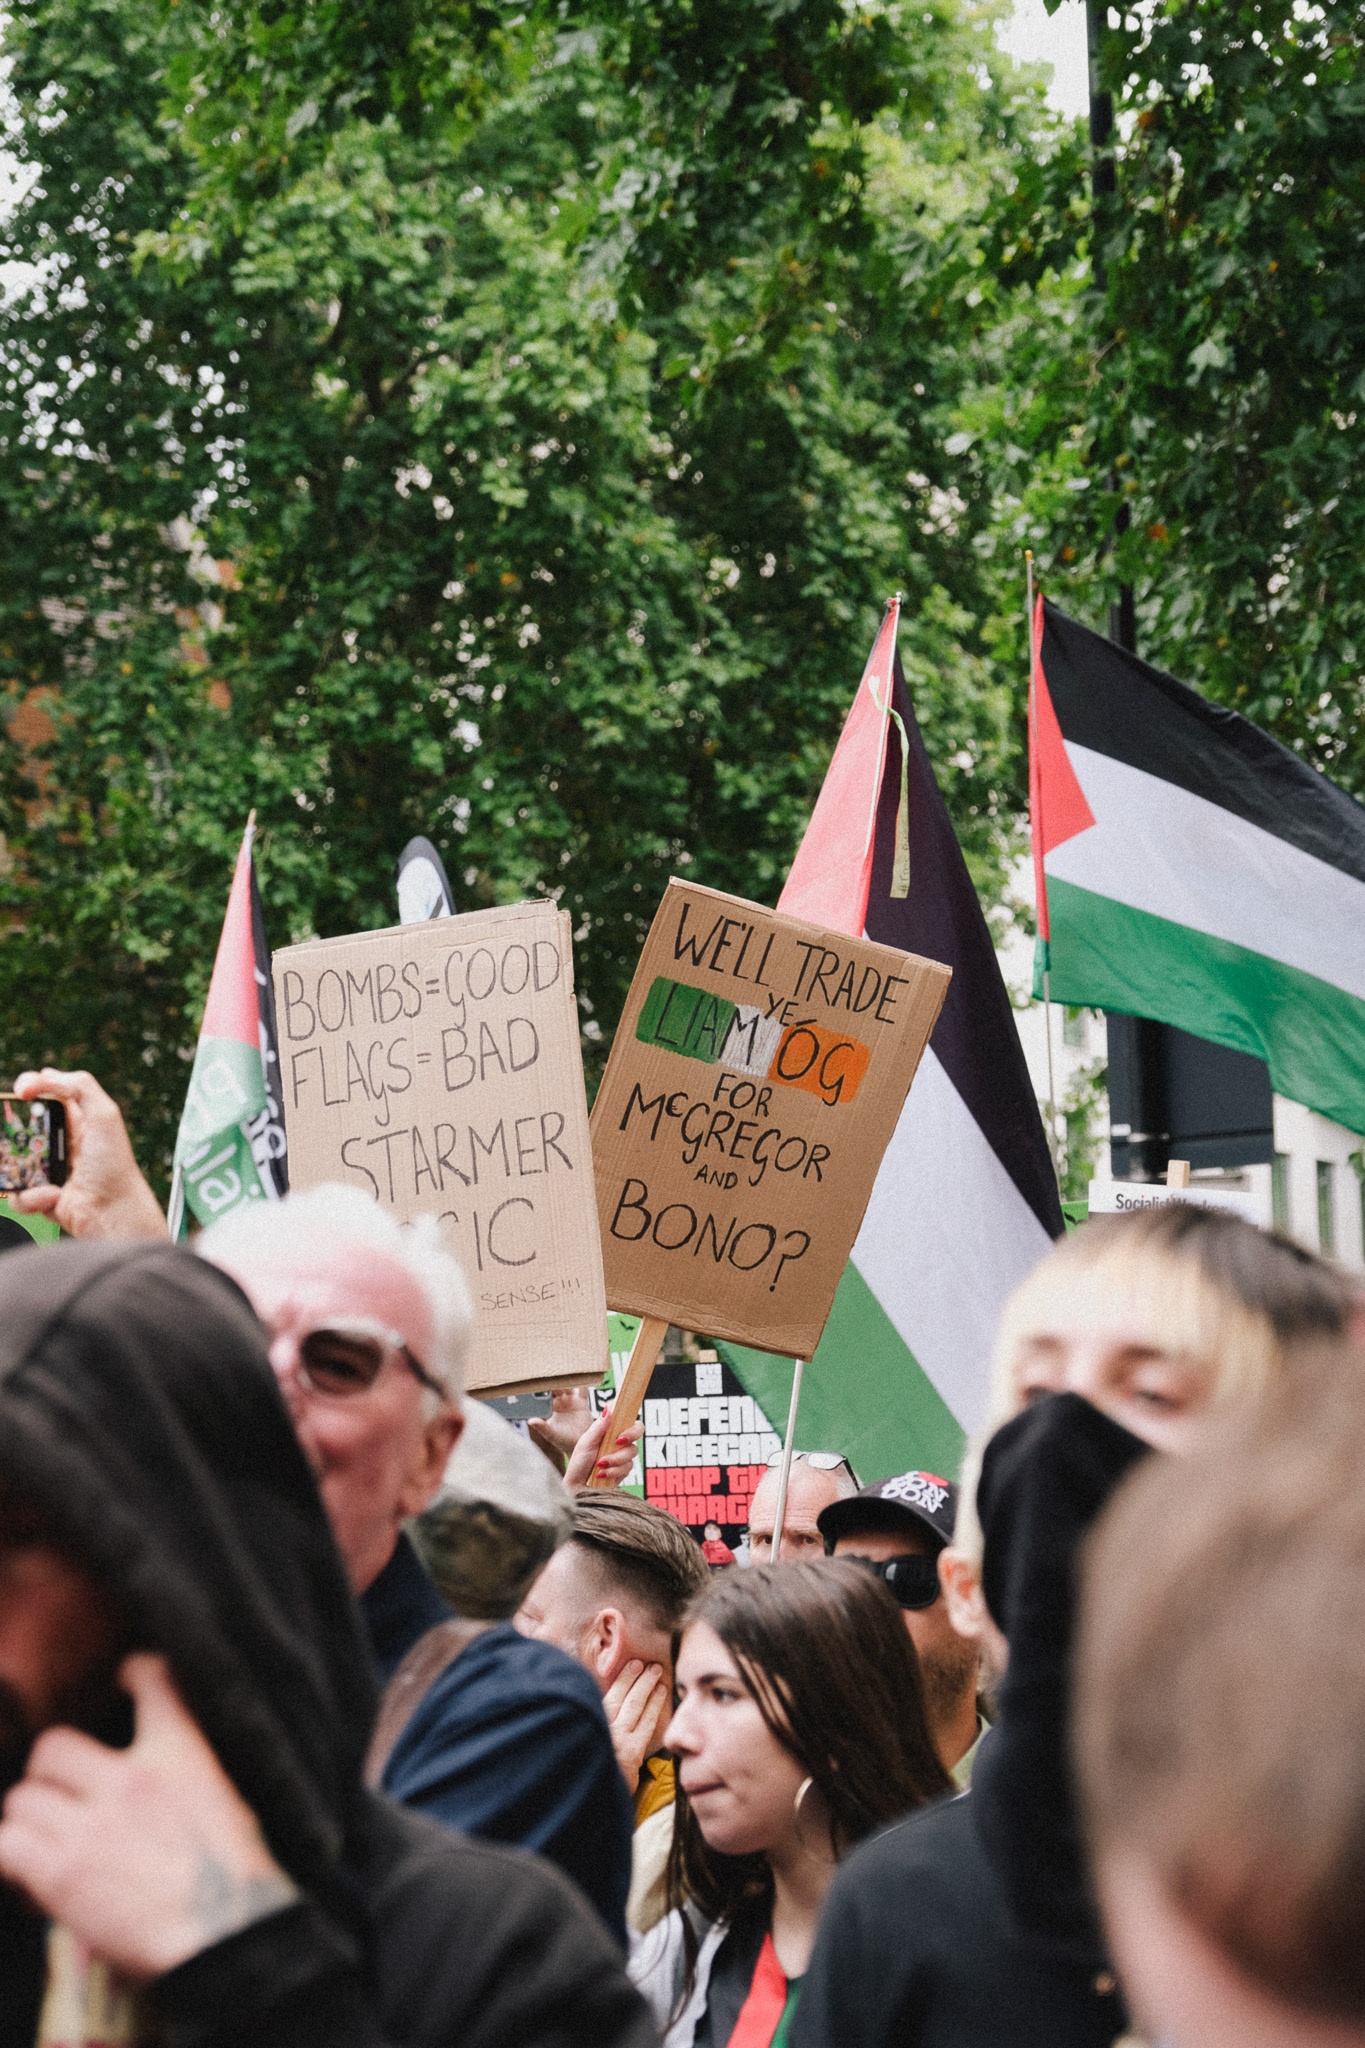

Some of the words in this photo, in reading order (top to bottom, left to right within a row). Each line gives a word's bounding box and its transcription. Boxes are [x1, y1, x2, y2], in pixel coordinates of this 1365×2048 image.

[764, 993, 799, 1027] YE
[796, 940, 910, 1025] TRADE
[654, 983, 759, 1066] LIAM
[714, 1073, 773, 1117] FOR
[341, 1112, 574, 1203] STARMER
[694, 1164, 739, 1190] AND
[610, 1179, 812, 1292] BONO?
[646, 1466, 721, 1496] DROP
